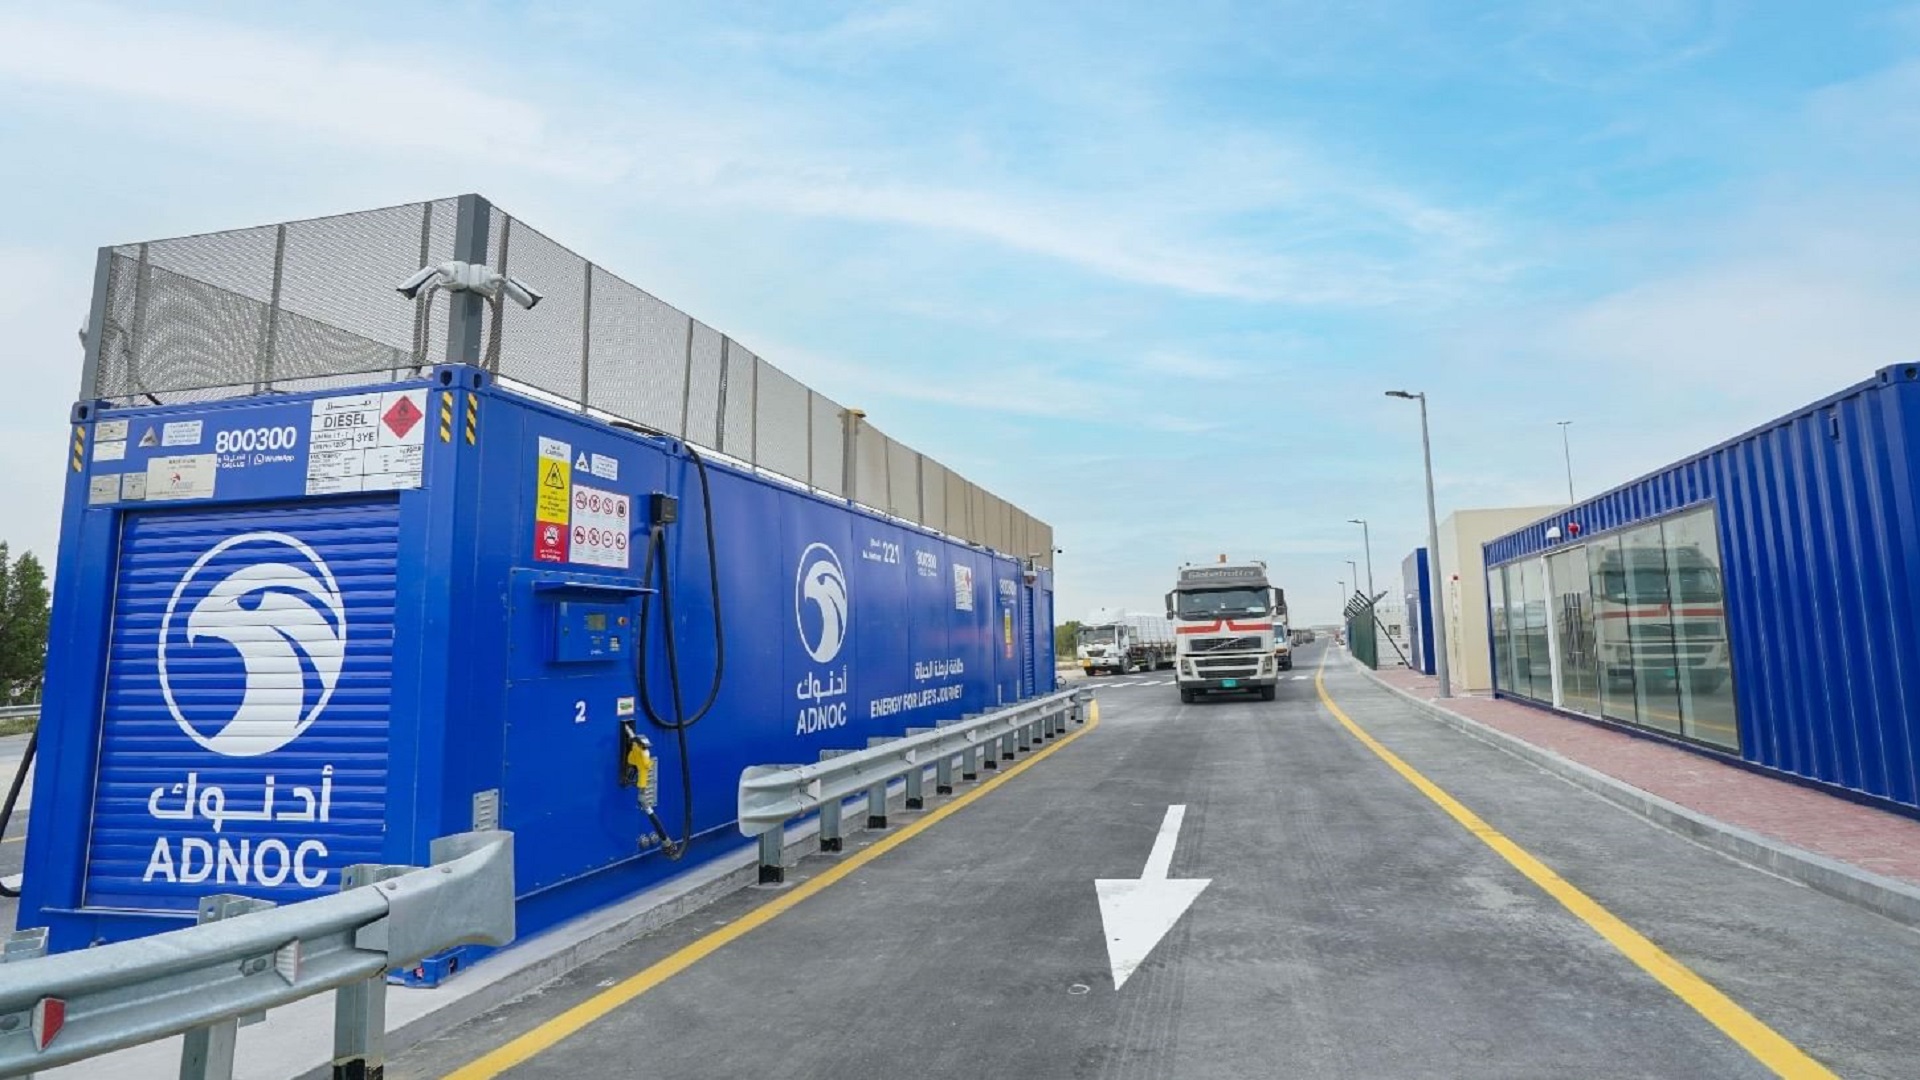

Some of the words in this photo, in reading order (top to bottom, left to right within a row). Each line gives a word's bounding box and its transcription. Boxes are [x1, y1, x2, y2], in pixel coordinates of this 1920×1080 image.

[323, 413, 369, 428] DIESEL
[215, 426, 297, 454] 800300
[882, 541, 900, 564] 221
[796, 664, 847, 704] أدنوك
[870, 695, 903, 719] ENERGY
[903, 692, 918, 711] FOR
[937, 683, 964, 703] JOURNEY
[575, 701, 587, 723] 2
[796, 701, 847, 736] ADNOC
[148, 764, 334, 834] أدنوك
[142, 836, 329, 888] ADNOC
